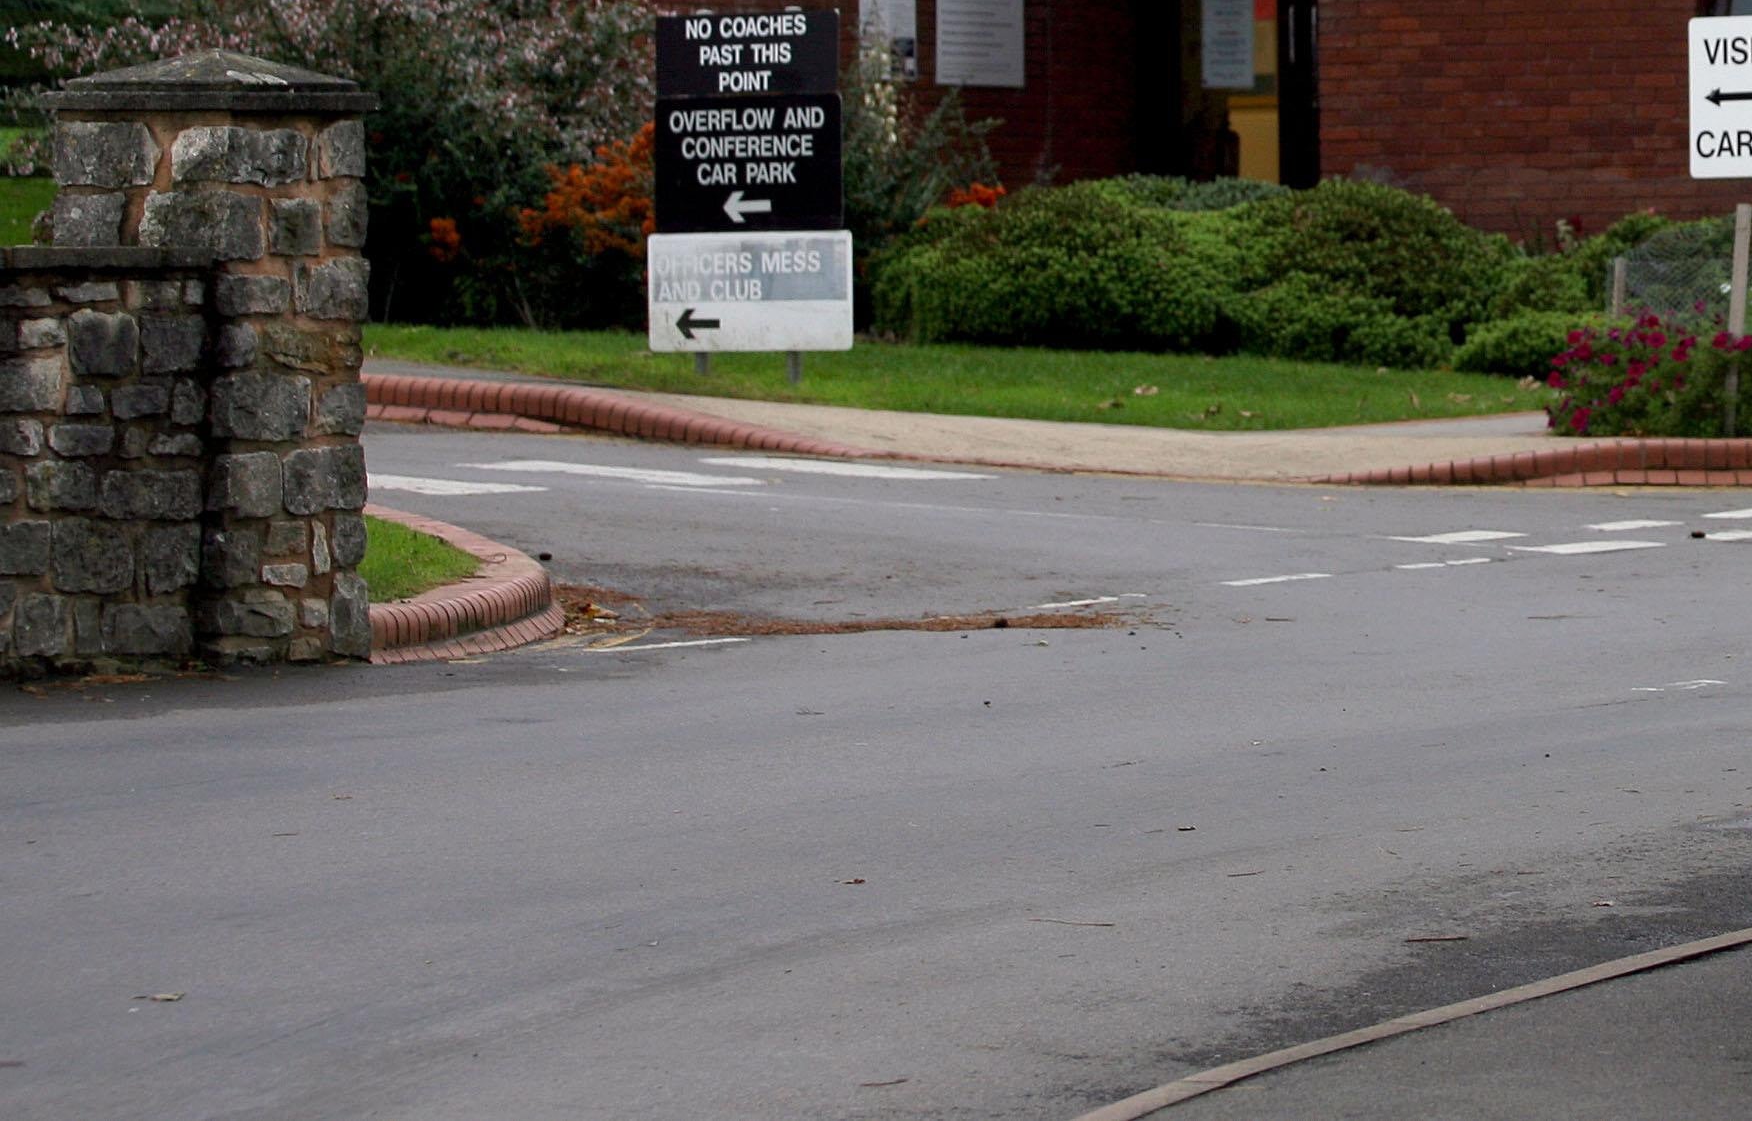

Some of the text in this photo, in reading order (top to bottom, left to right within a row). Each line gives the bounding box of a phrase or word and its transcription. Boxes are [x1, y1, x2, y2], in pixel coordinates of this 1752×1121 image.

[685, 14, 807, 39] NO COACHES
[700, 42, 792, 66] PAST THIS
[718, 70, 772, 93] POINT
[669, 106, 825, 134] OVERFLOW AND
[681, 134, 814, 160] CONFERENCE
[697, 161, 797, 186] CAR PARK
[761, 249, 821, 274] MESS
[658, 278, 763, 301] AND CLUB
